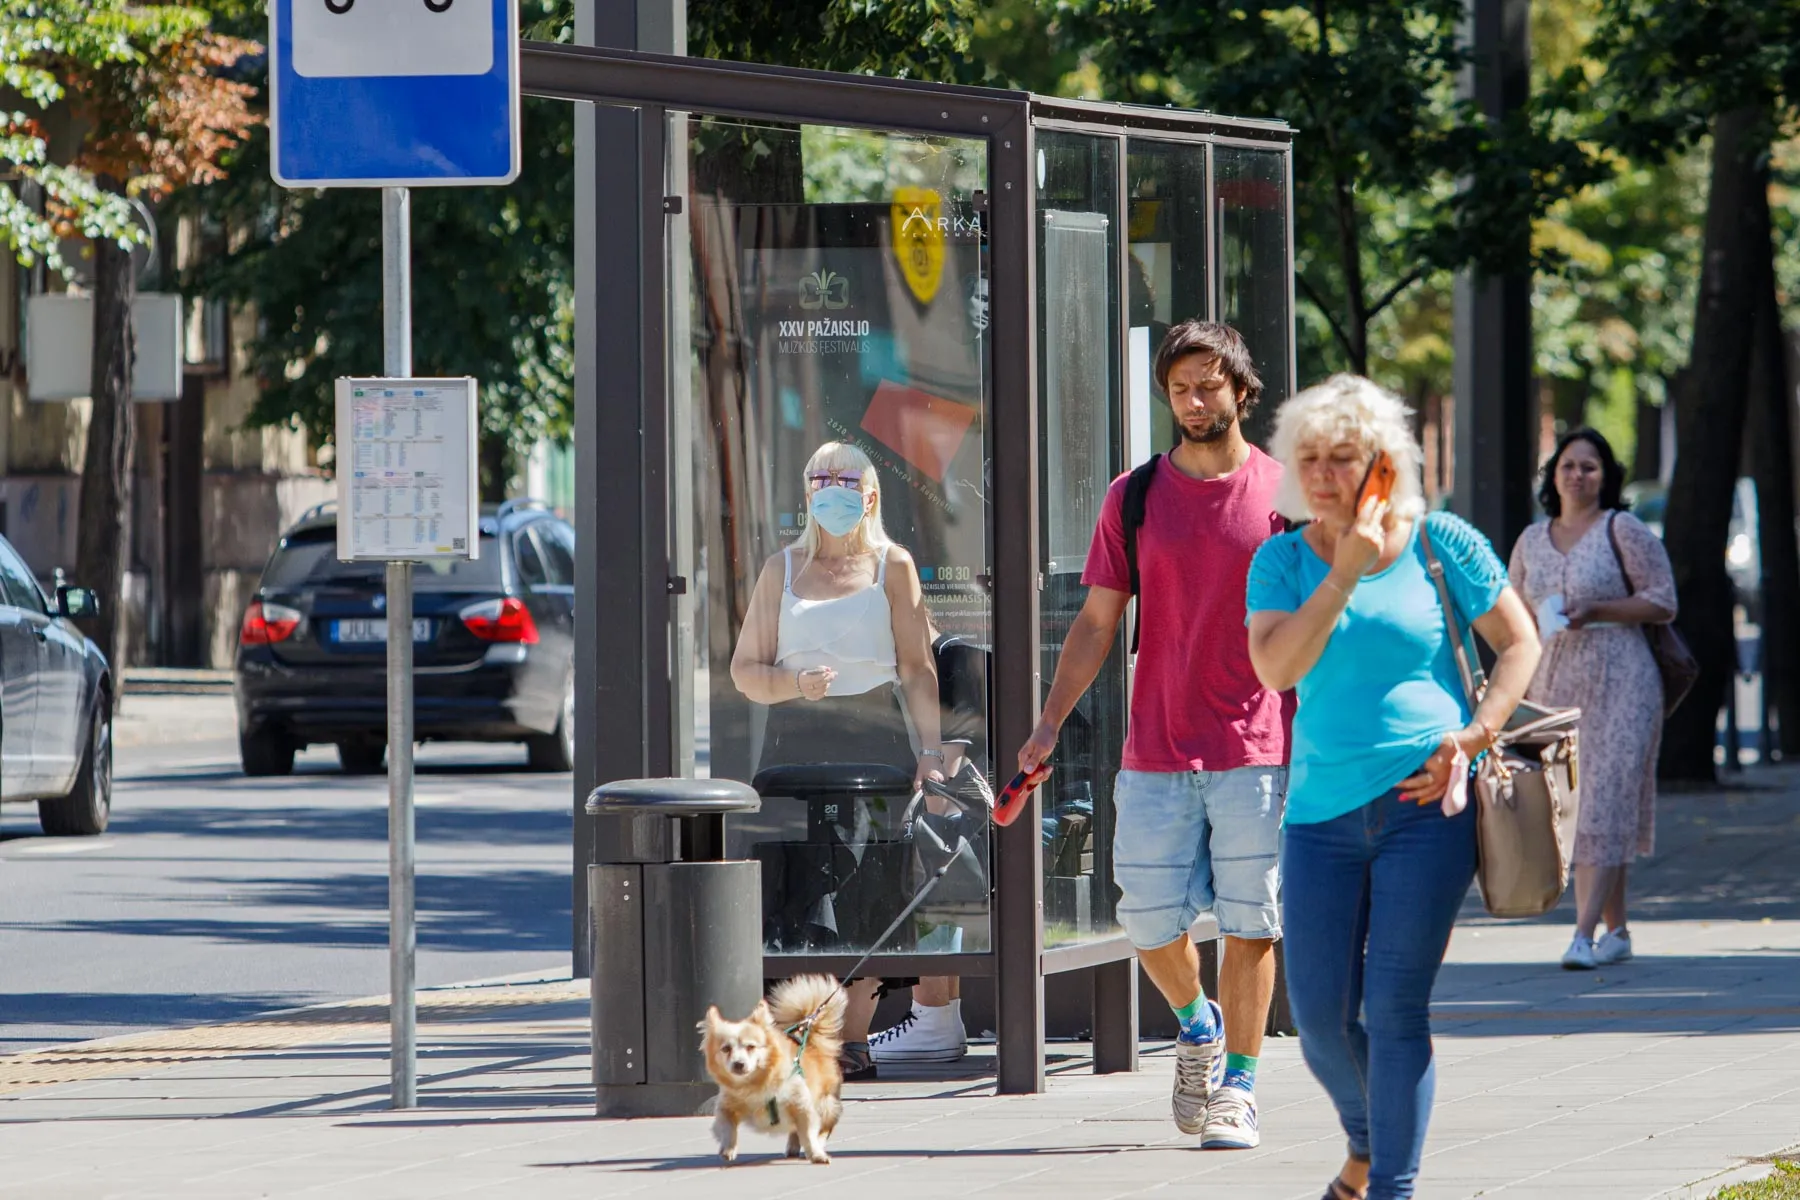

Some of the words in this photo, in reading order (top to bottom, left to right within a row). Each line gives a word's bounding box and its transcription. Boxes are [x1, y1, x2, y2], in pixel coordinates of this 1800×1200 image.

[901, 206, 981, 232] ARKA
[779, 320, 805, 337] XXV
[807, 317, 870, 337] PAŽAISLIO
[778, 340, 818, 354] MUZIKOS
[819, 340, 871, 354] FESTIVALIS
[827, 418, 848, 436] 2020
[937, 566, 953, 581] 08
[955, 566, 970, 581] 30
